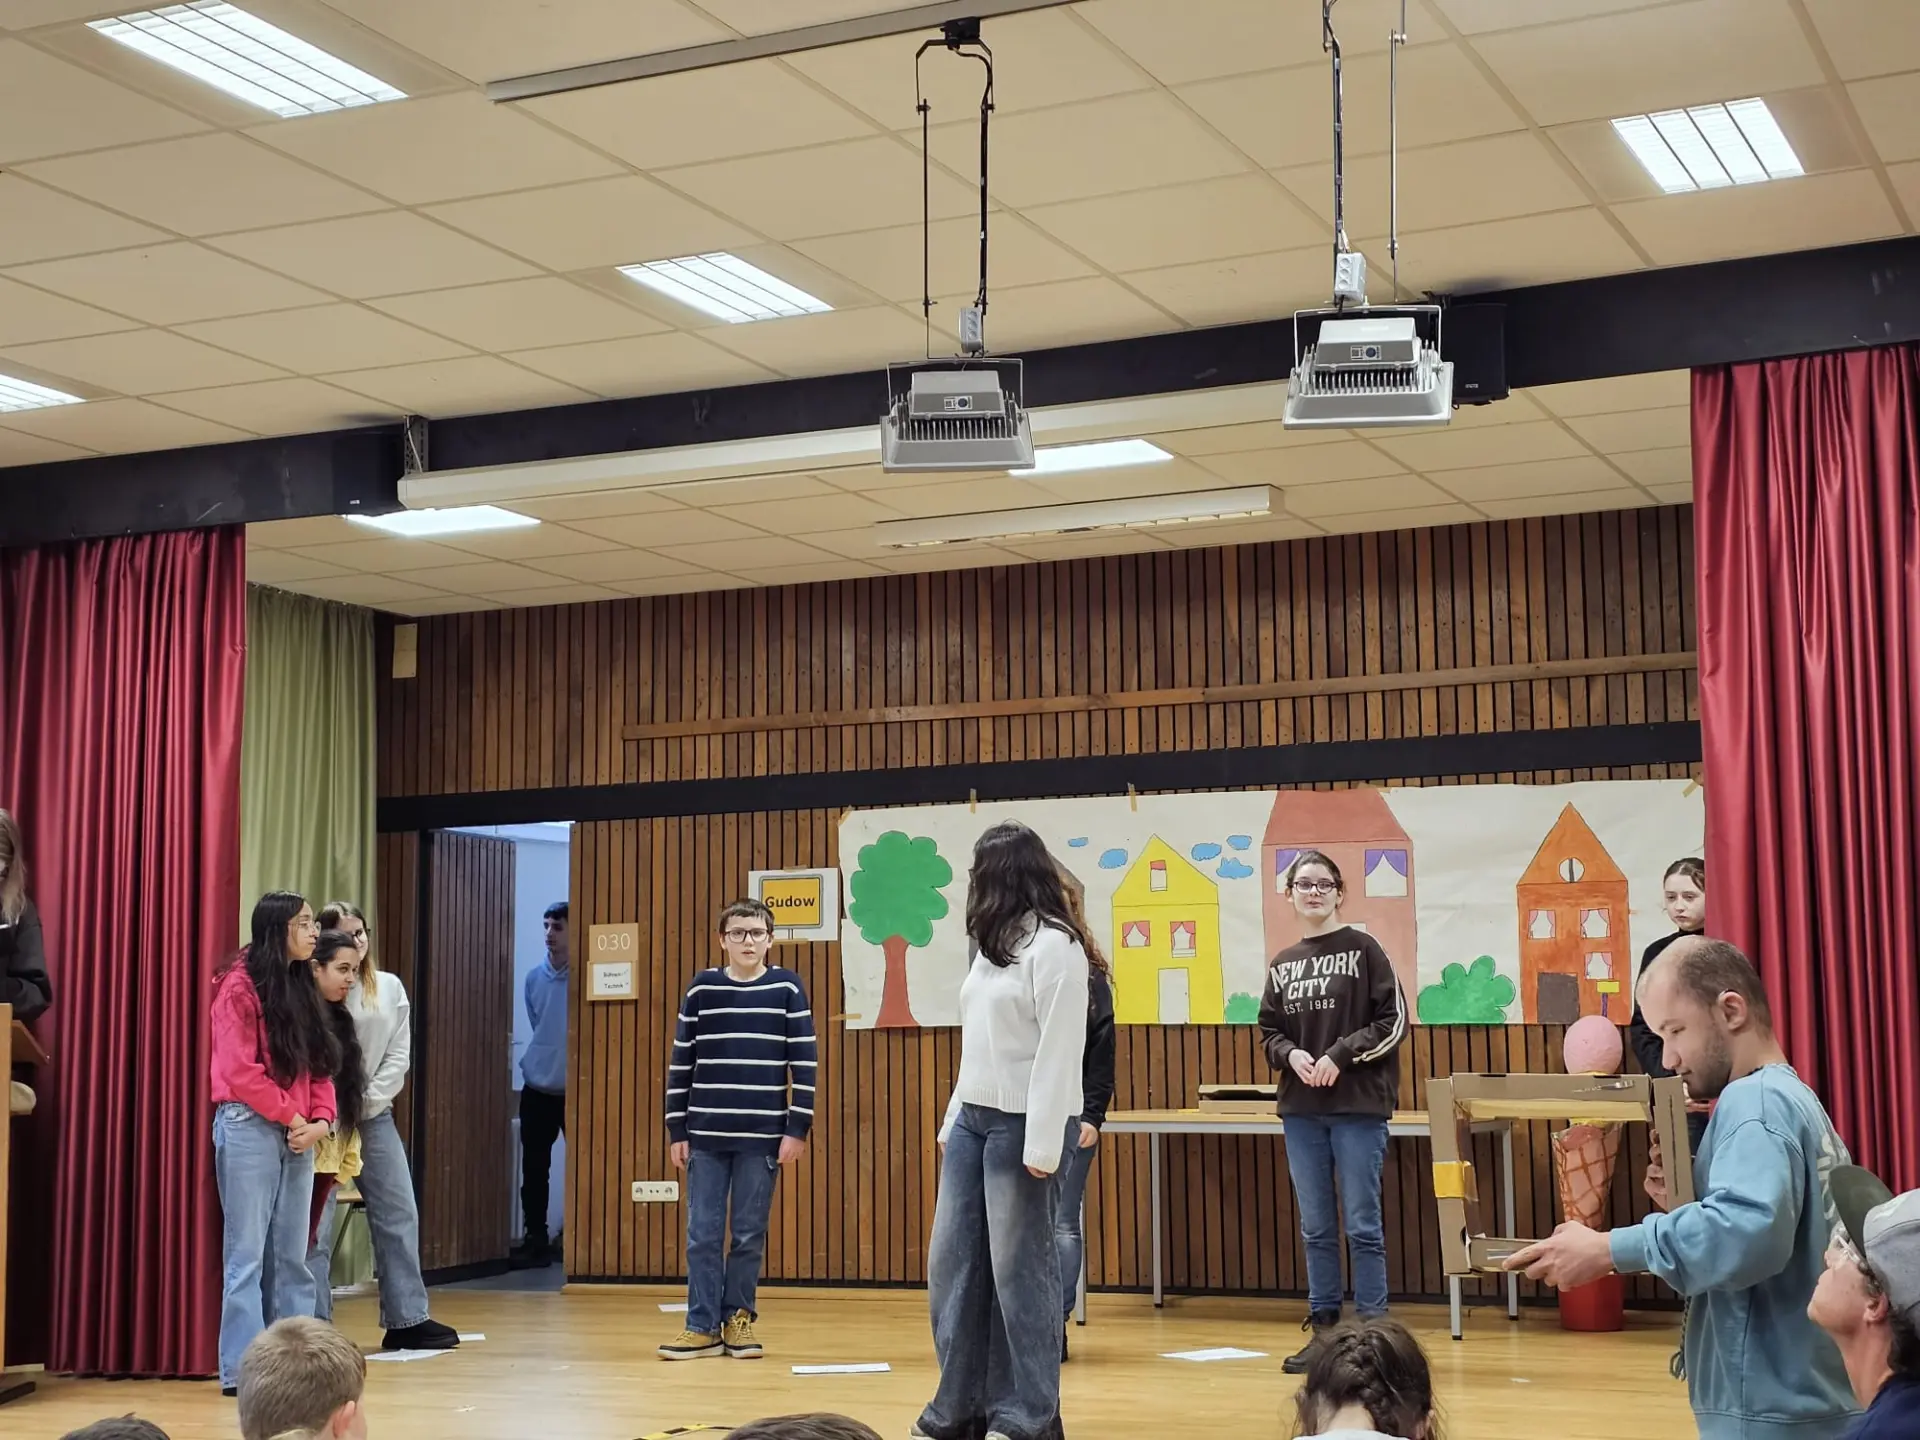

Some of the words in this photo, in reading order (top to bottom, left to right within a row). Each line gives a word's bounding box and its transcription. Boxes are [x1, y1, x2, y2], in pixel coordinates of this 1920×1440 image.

[764, 894, 815, 908] Gudow
[1269, 958, 1307, 993] NEW
[1311, 949, 1361, 978] YORK
[1287, 976, 1331, 1000] CITY
[1283, 1002, 1304, 1015] EST.
[1309, 998, 1335, 1010] 1982
